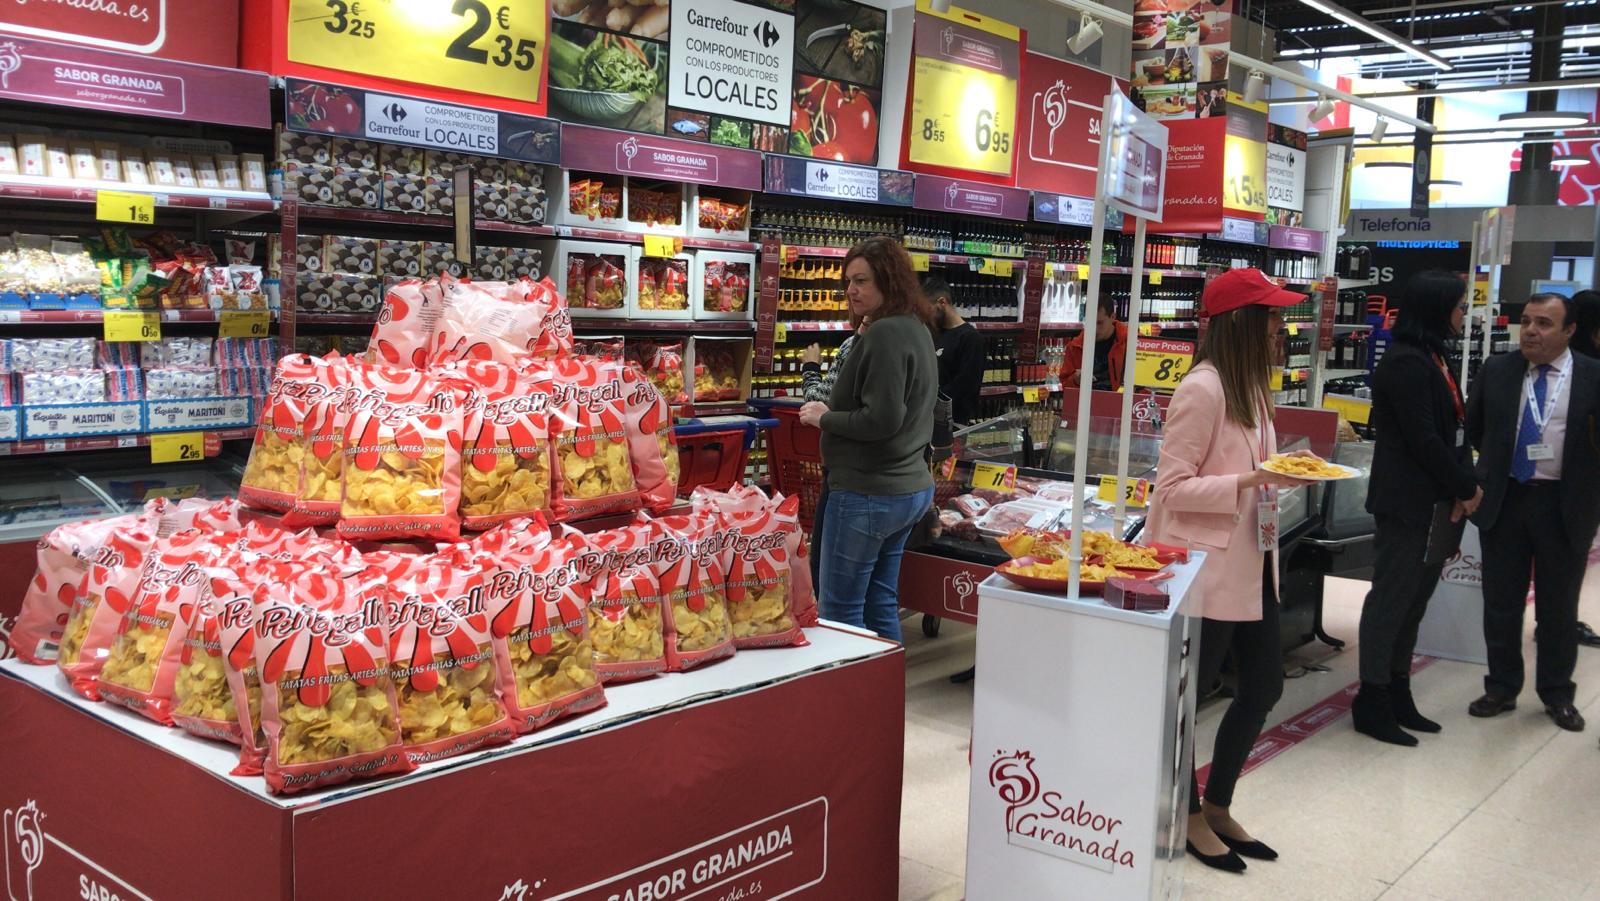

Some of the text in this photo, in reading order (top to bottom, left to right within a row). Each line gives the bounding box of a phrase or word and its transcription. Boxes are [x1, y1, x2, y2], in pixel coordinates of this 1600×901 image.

[687, 8, 749, 37] Carrefour
[686, 37, 780, 69] COMPROMETIDOS
[54, 66, 164, 92] SABOR GRANADA
[686, 56, 779, 83] CON LOS PRODUCTORES
[685, 72, 778, 111] LOCALES
[424, 106, 496, 125] COMPROMETIDOS
[368, 121, 421, 139] Carrefour
[424, 127, 496, 151] LOCALES
[653, 151, 707, 167] SABOR GRANADA
[1174, 153, 1204, 161] Granada
[837, 184, 877, 199] LOCALES
[1360, 217, 1431, 232] Telefonía
[1161, 342, 1190, 351] Precio
[281, 676, 316, 690] PATATAS
[318, 672, 349, 685] FRITAS
[391, 666, 425, 680] PATATAS
[426, 660, 454, 672] FRITAS
[1040, 791, 1122, 835] Sabor
[1016, 813, 1135, 868] Granada
[692, 825, 792, 885] GRANADA
